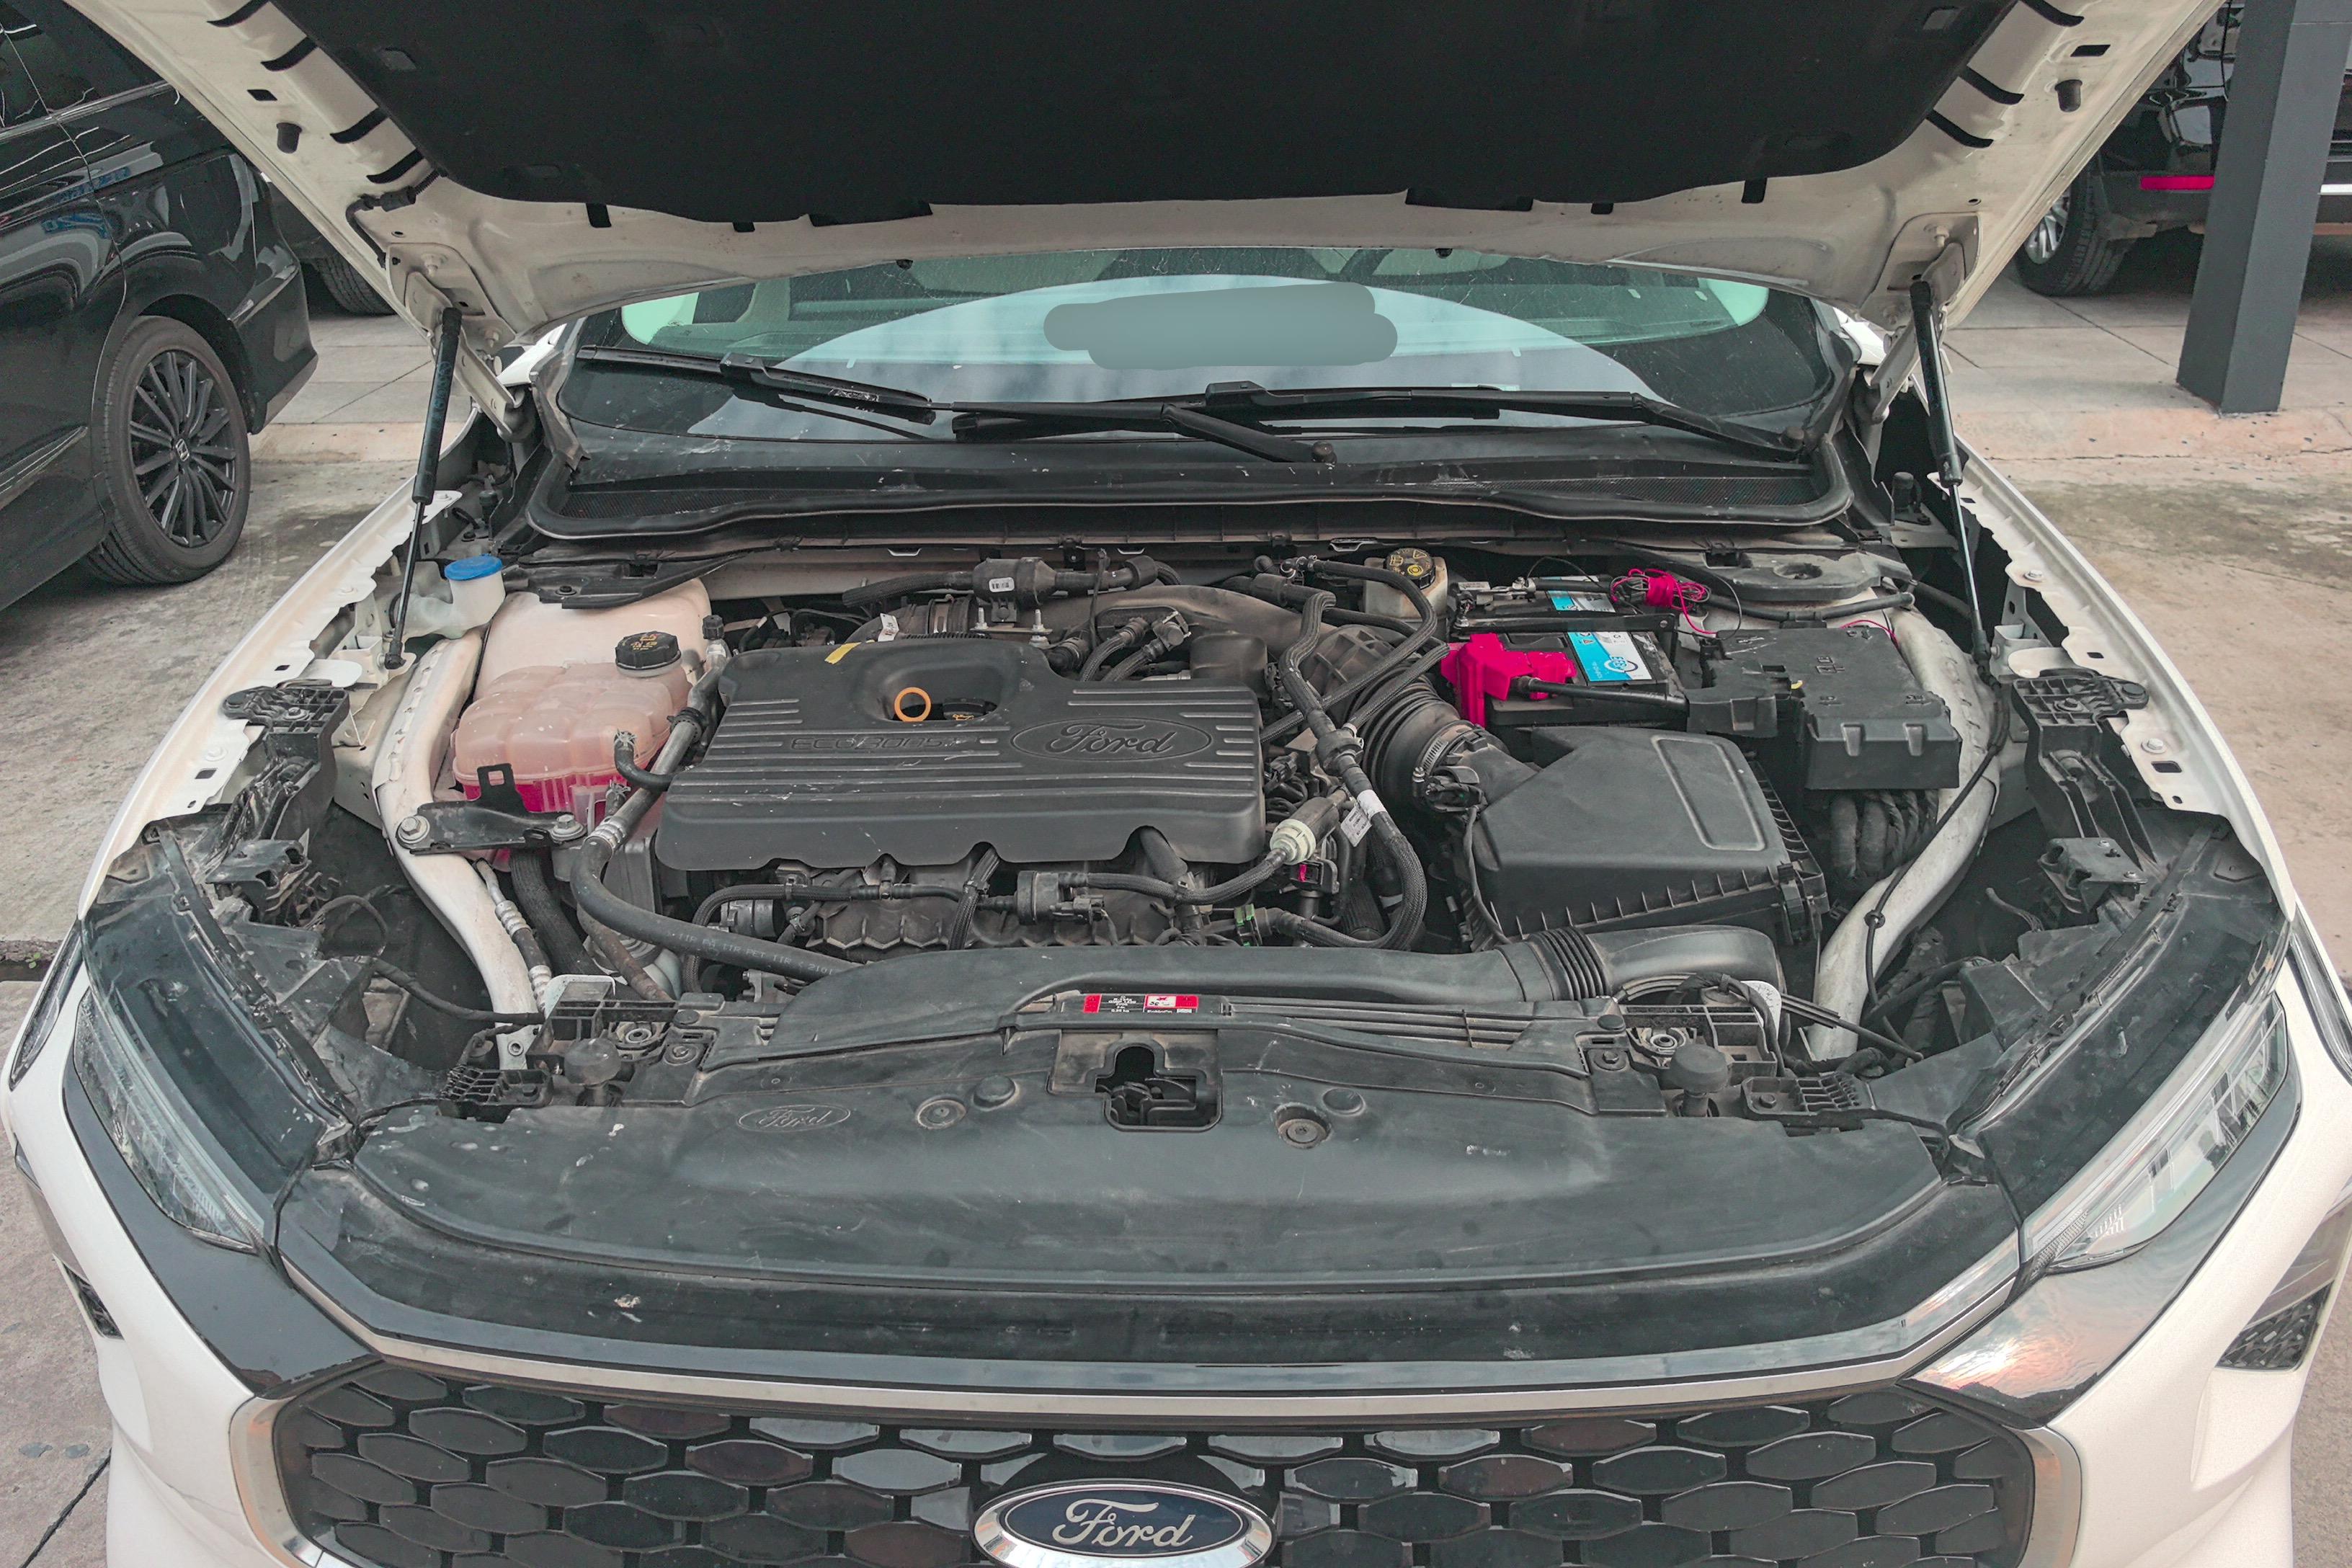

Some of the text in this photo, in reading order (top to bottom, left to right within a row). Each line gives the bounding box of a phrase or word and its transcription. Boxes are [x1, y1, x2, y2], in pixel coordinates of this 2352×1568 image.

[1047, 722, 1177, 753] Ford
[759, 1108, 832, 1128] Ford
[1052, 1498, 1196, 1547] Ford
